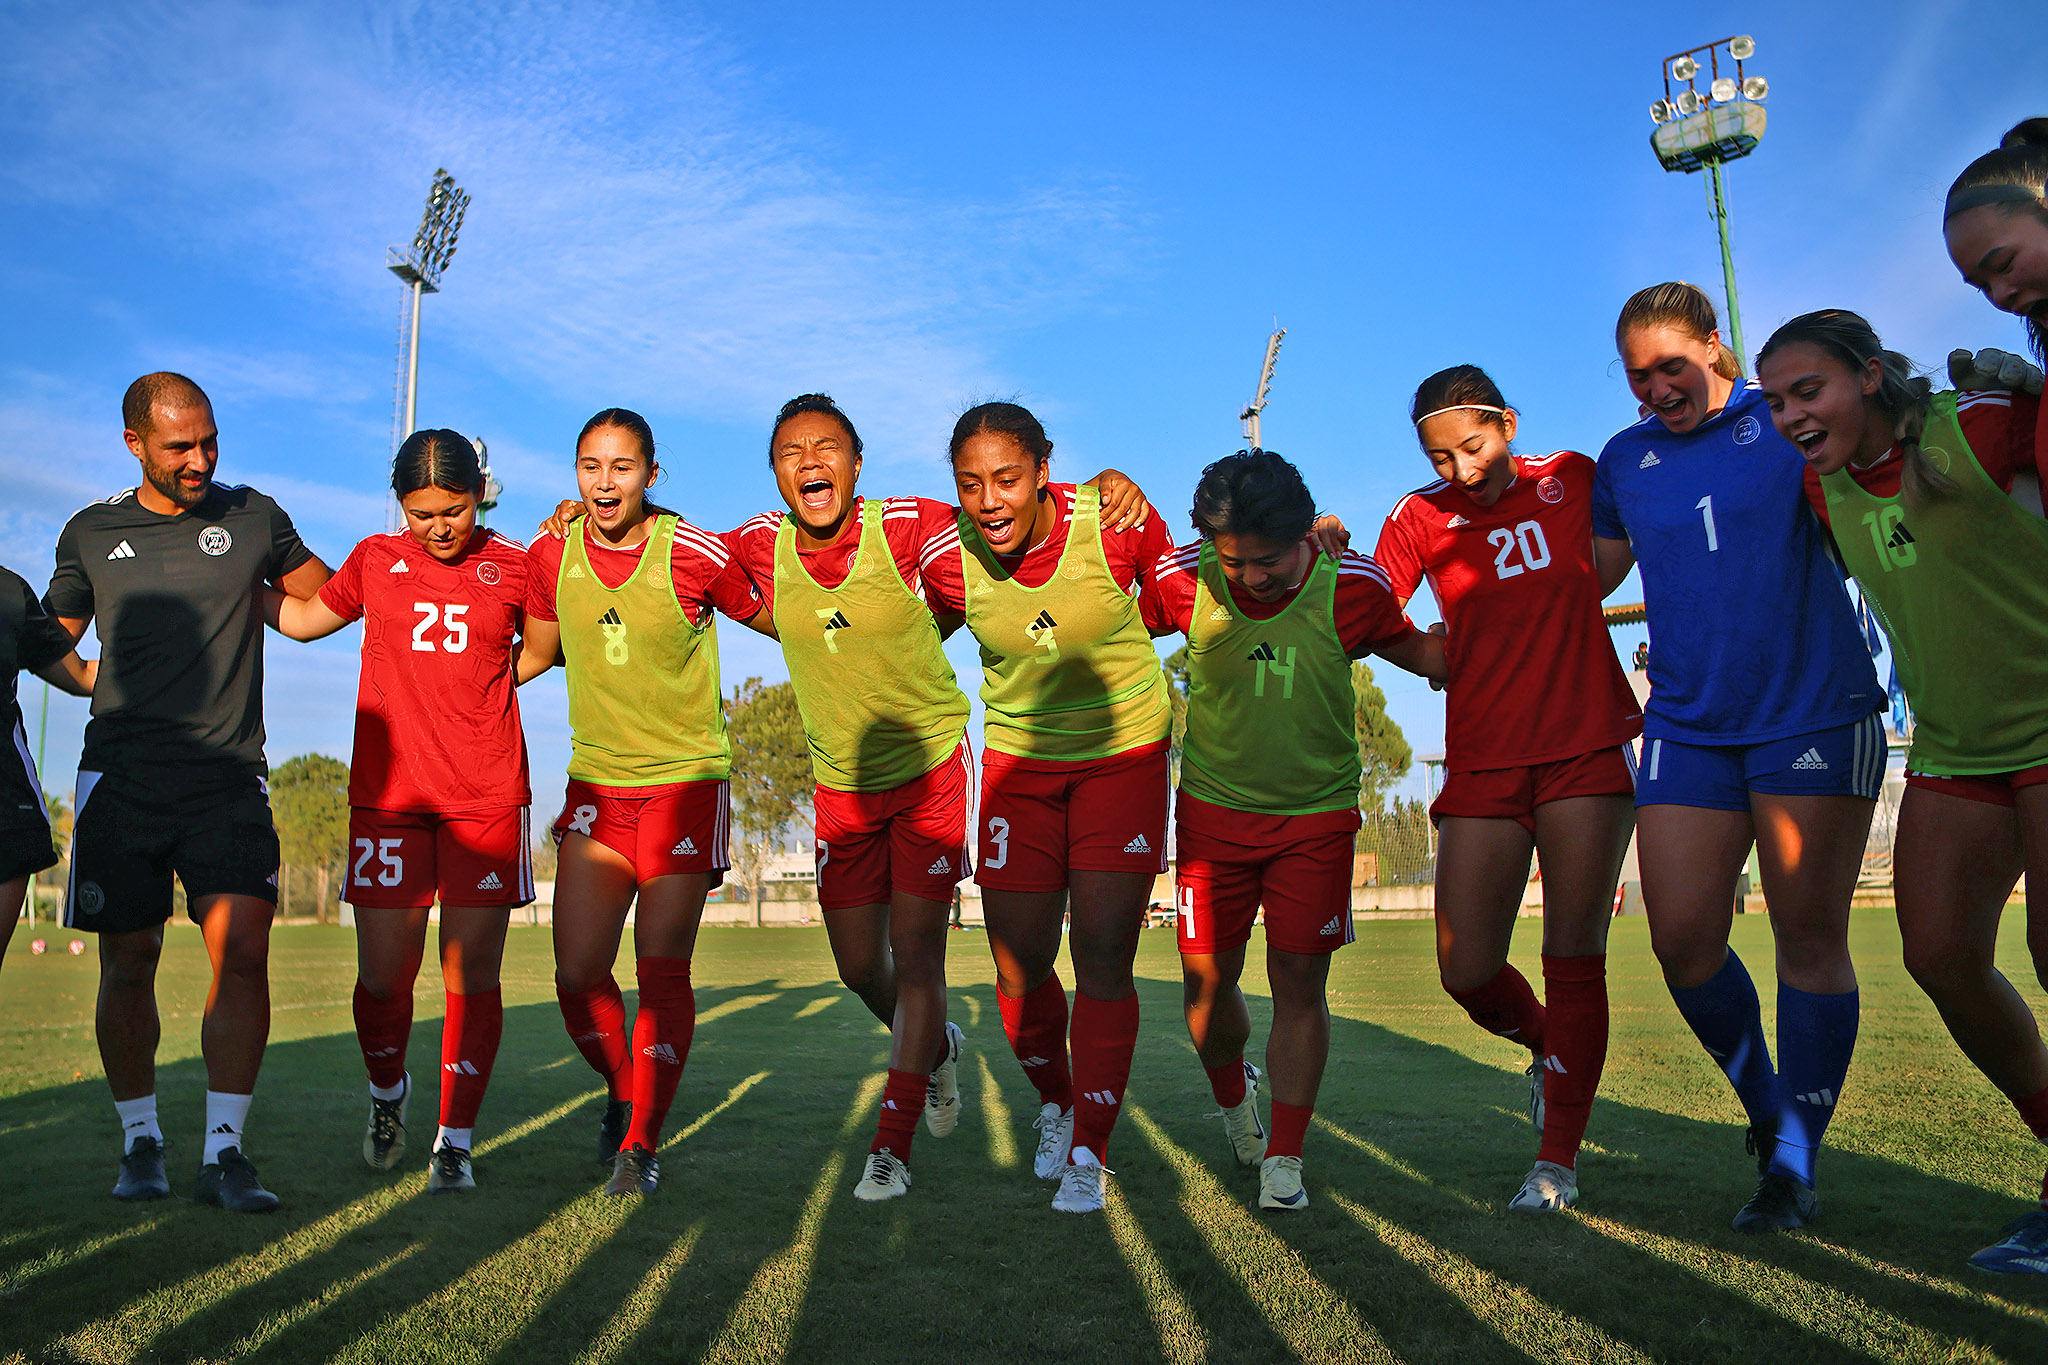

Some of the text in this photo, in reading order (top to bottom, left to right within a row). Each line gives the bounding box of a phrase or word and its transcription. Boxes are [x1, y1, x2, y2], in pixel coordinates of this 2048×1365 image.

[1694, 495, 1718, 552] 1
[1487, 520, 1551, 580] 20
[411, 602, 470, 653] 25
[602, 623, 629, 666] 8
[815, 607, 839, 654] 7
[1025, 621, 1060, 664] 3
[1250, 645, 1296, 699] 14
[1791, 761, 1828, 770] adidas
[568, 805, 598, 836] 8
[985, 816, 1010, 869] 3
[354, 838, 404, 887] 25
[671, 847, 699, 855] adidas
[1123, 845, 1151, 853] adidas
[477, 881, 504, 890] adidas
[1175, 885, 1196, 939] 4
